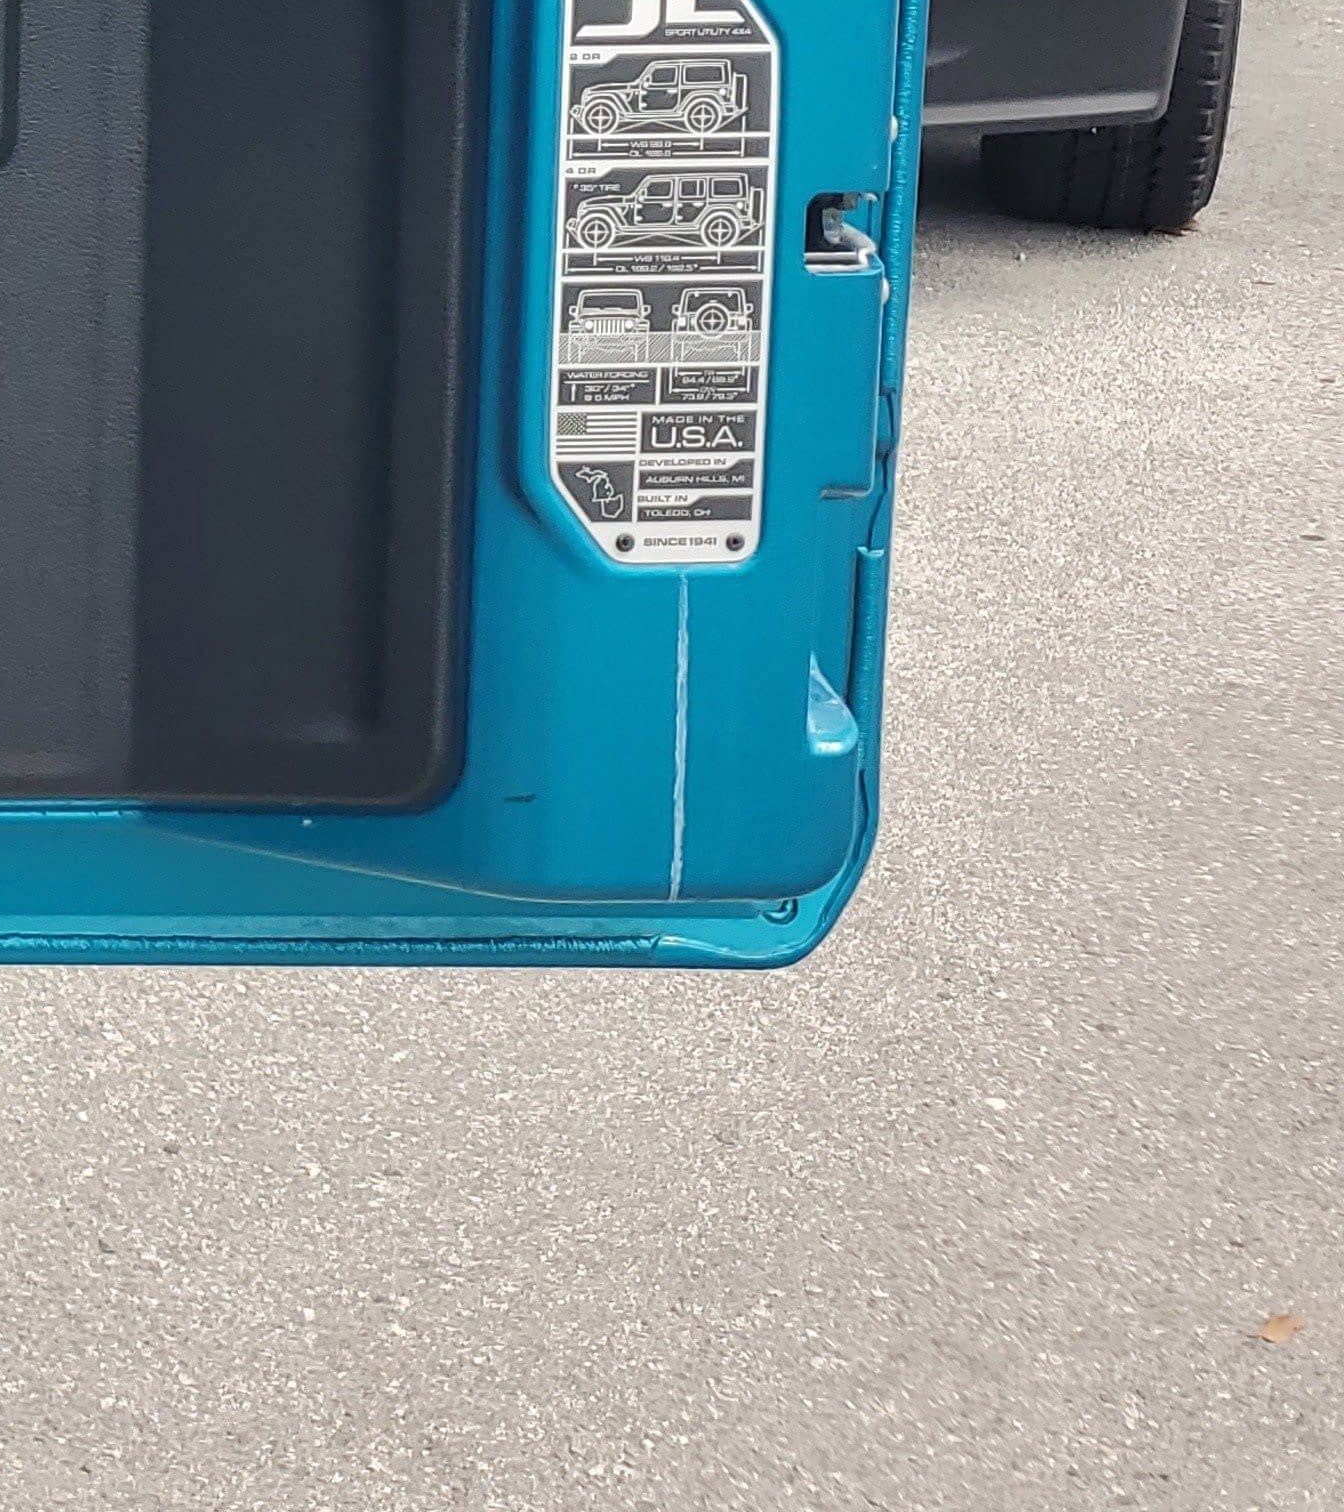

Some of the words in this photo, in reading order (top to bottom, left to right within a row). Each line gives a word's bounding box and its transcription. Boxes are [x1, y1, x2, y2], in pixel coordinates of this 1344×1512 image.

[664, 28, 696, 37] SPORT
[697, 27, 731, 36] UTILITY
[569, 53, 578, 61] 2
[582, 52, 601, 61] DR
[565, 167, 574, 175] 4
[578, 167, 597, 175] DR
[566, 371, 603, 379] WATER
[603, 370, 648, 379] FORDING
[604, 393, 630, 401] MPH
[651, 415, 694, 424] MADE
[698, 415, 714, 424] IN
[717, 414, 745, 423] THE
[651, 426, 744, 448] U.S.A.
[638, 458, 711, 467] DEVELOPED
[714, 458, 726, 466] IN
[645, 475, 694, 484] AUBURN
[731, 475, 745, 483] MI
[637, 495, 671, 503] BUILT
[674, 494, 688, 503] IN
[644, 509, 691, 517] TOLEDO,
[694, 508, 711, 517] OH
[643, 537, 687, 546] SINCE
[690, 537, 717, 546] 1941
